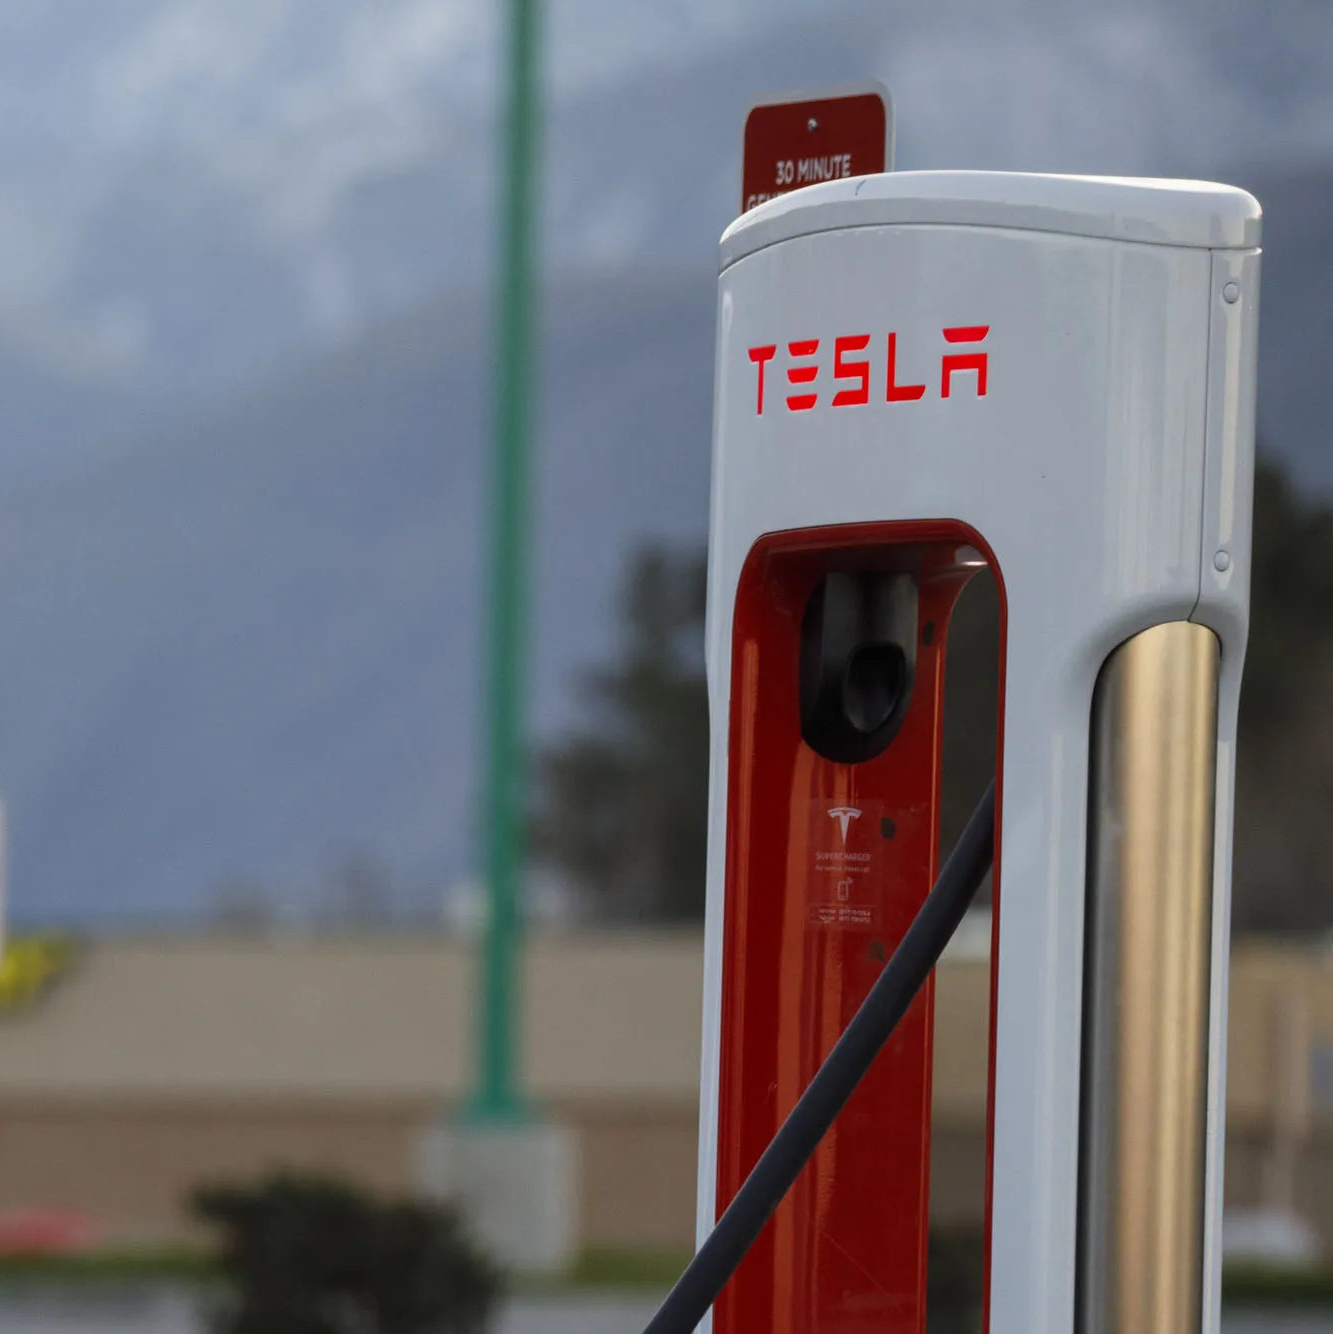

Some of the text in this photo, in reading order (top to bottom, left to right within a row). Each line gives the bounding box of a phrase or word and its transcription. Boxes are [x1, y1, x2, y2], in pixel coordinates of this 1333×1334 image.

[775, 153, 851, 185] 30 MINUTE
[747, 324, 990, 415] TESLA
